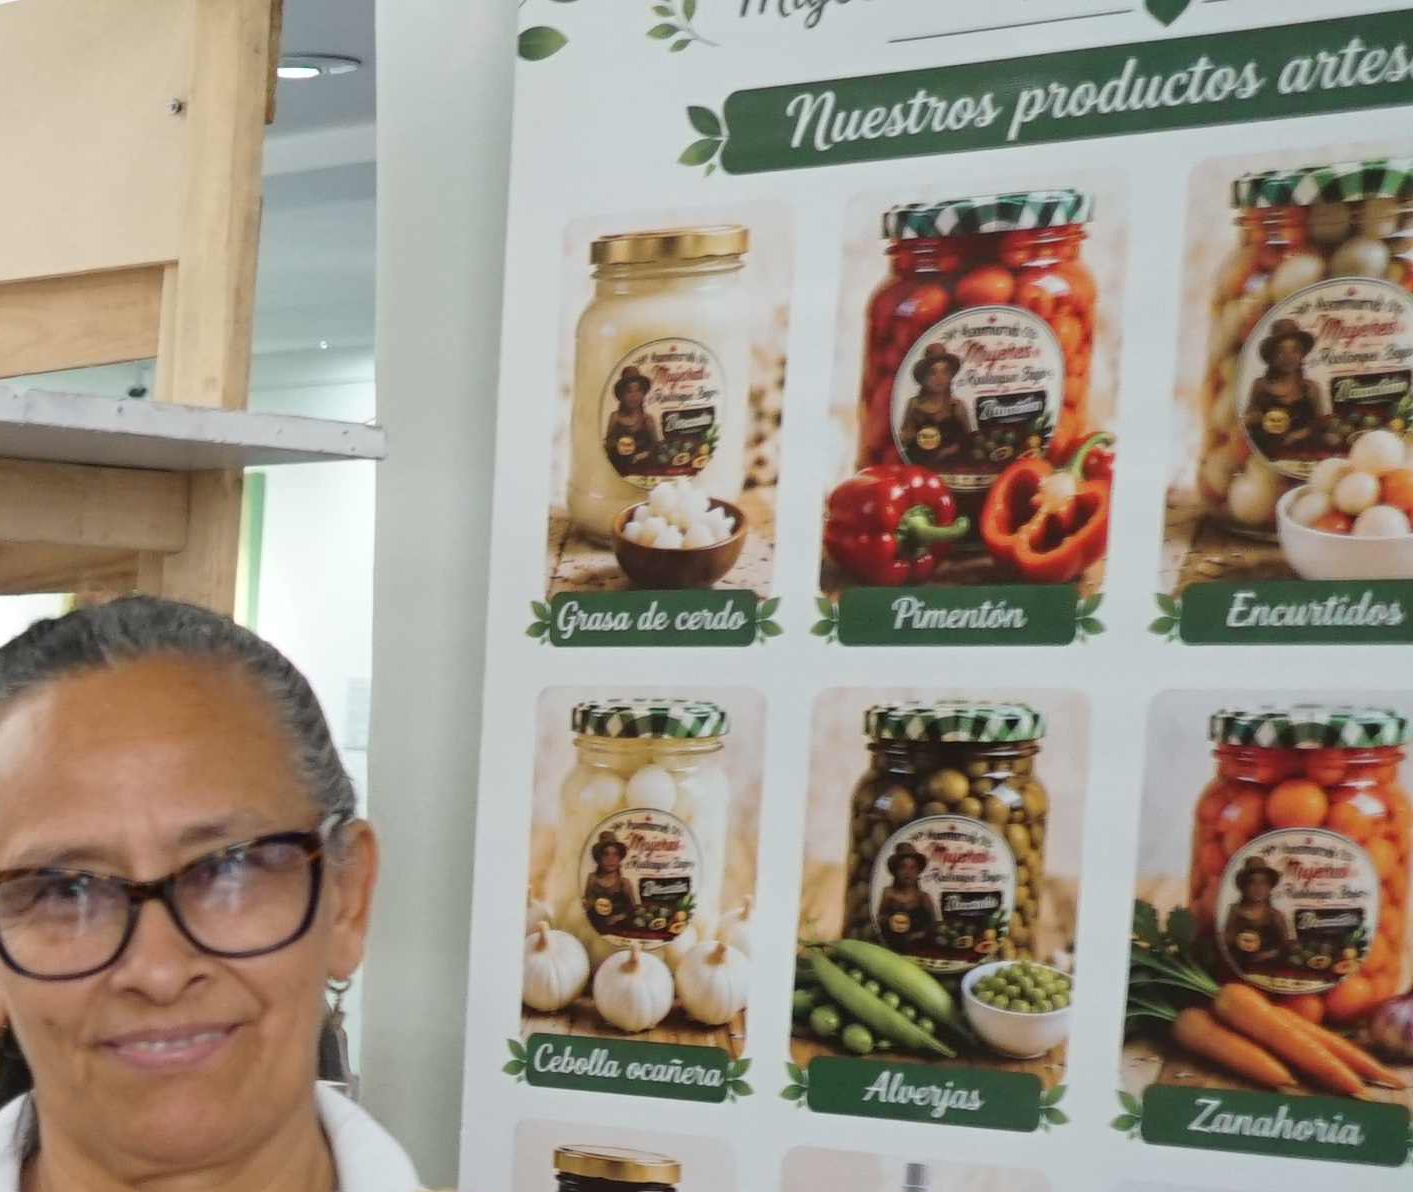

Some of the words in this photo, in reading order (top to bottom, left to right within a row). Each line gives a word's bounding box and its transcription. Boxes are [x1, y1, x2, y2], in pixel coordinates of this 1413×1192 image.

[785, 89, 1003, 151] Nuestros
[1006, 55, 1268, 142] productos
[1277, 35, 1413, 95] artes
[557, 600, 633, 639] Grasa
[636, 601, 671, 631] de
[674, 600, 749, 631] cerdo
[891, 594, 1030, 630] Pimentón
[1226, 590, 1405, 627] Encurtidos
[534, 1043, 622, 1078] Cebolla
[625, 1059, 725, 1087] ocañera
[861, 1070, 985, 1119] Alverjas
[1187, 1098, 1366, 1145] Zanahoria
